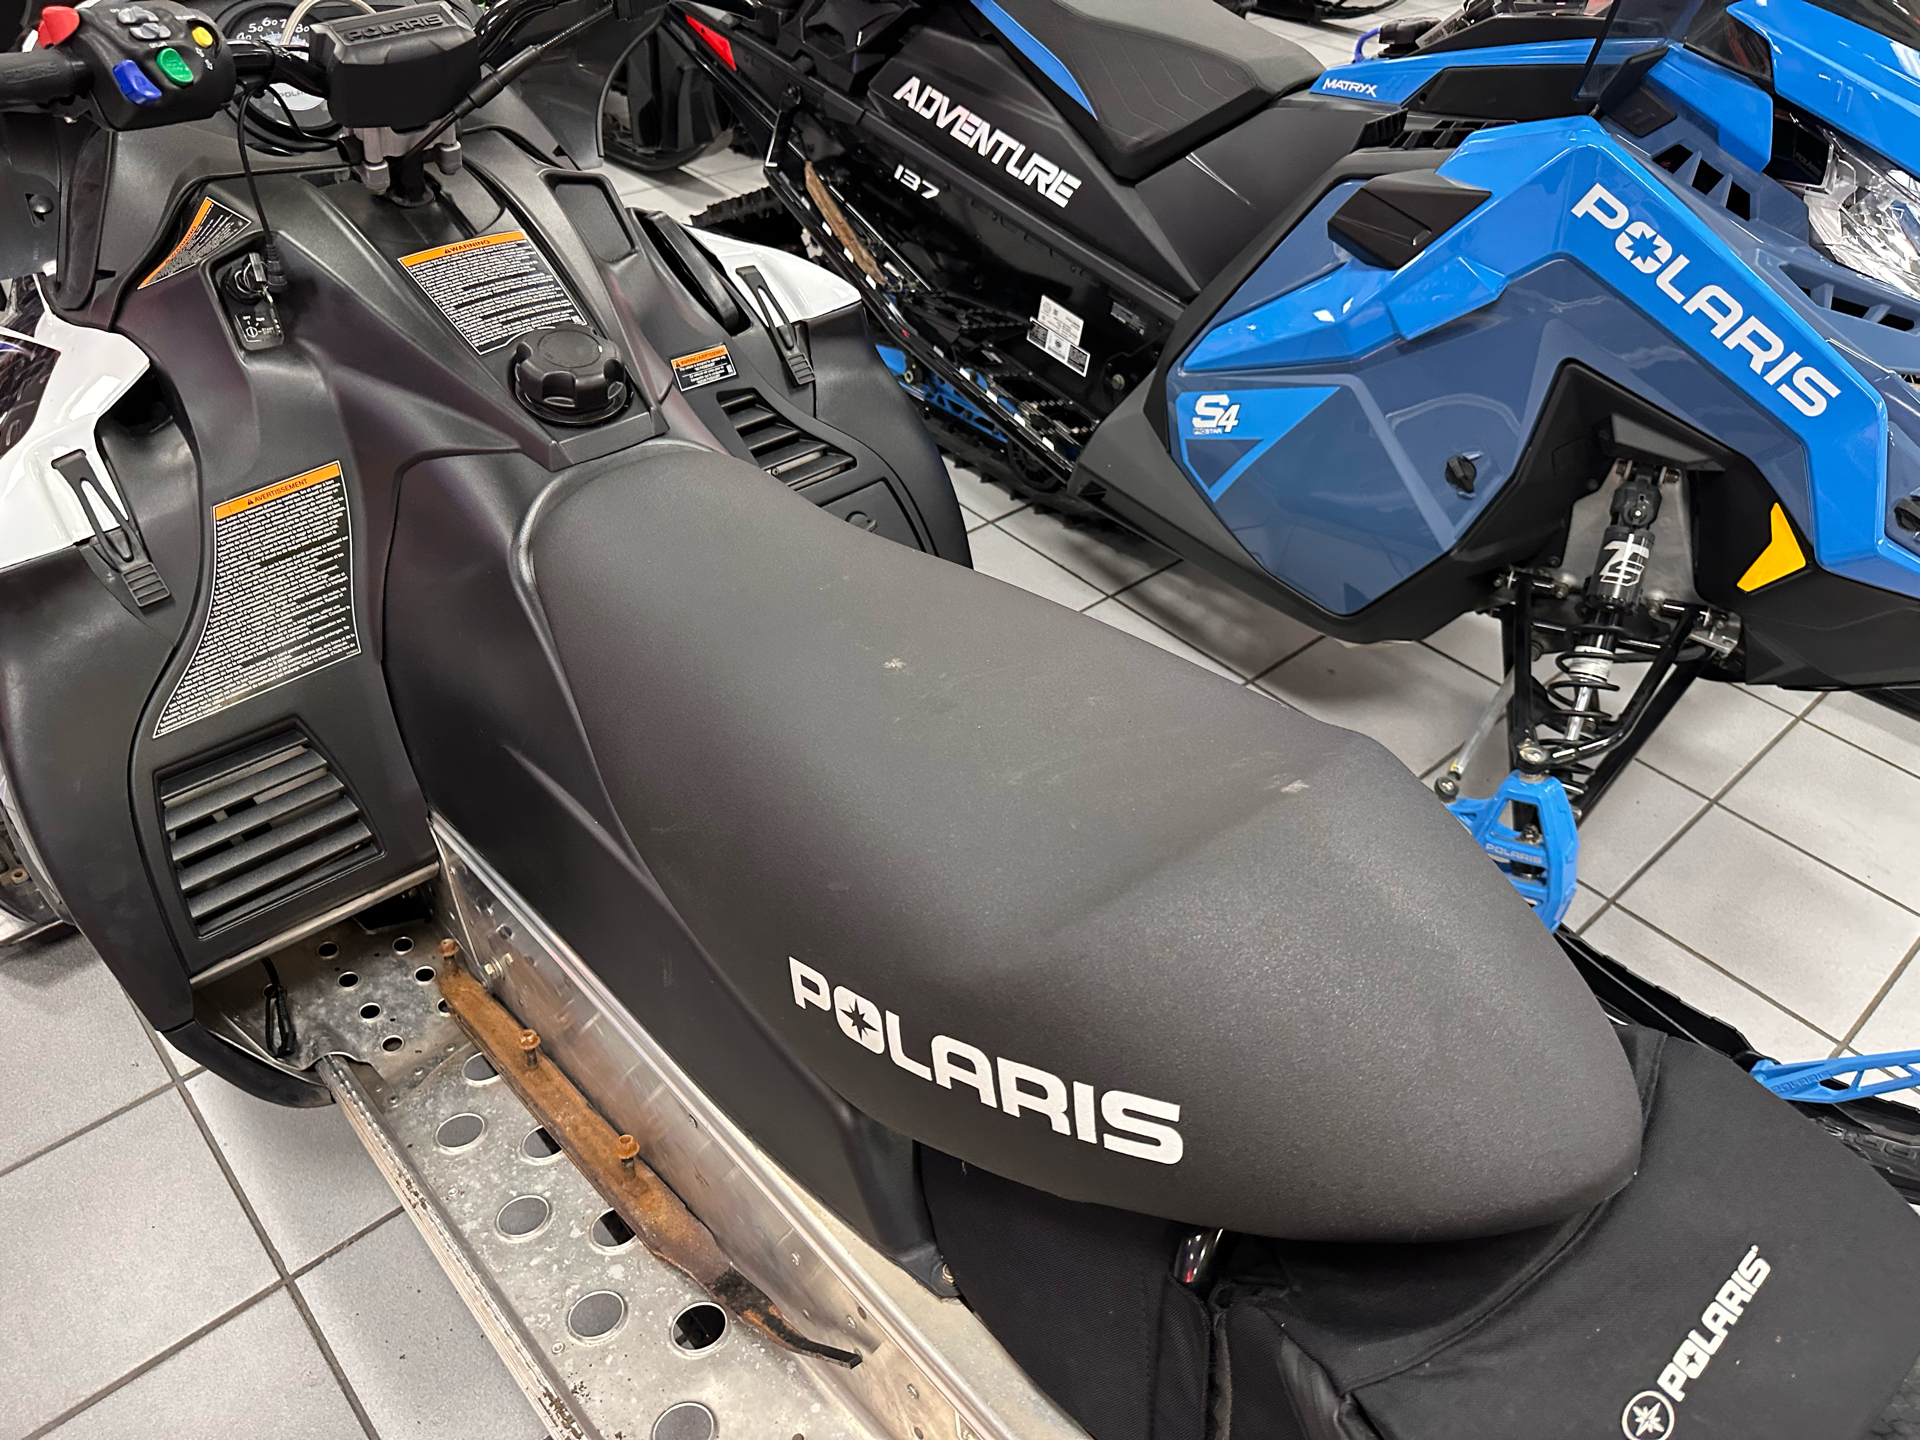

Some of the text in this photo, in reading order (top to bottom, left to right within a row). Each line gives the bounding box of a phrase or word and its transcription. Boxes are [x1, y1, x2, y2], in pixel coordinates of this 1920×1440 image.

[247, 23, 264, 33] 50
[262, 17, 278, 27] 60
[344, 15, 443, 42] POLARIS
[1322, 78, 1378, 97] MATRYX
[893, 75, 1082, 209] ADVENTURE
[893, 164, 940, 199] 137
[450, 239, 491, 253] WARNING
[1570, 182, 1842, 418] POLARIS
[1192, 394, 1240, 433] S4
[254, 478, 308, 503] AVERTISSEMENT
[1485, 842, 1542, 864] POLARIS
[789, 956, 1184, 1165] POLARIS
[1656, 1245, 1771, 1402] POLARIS
